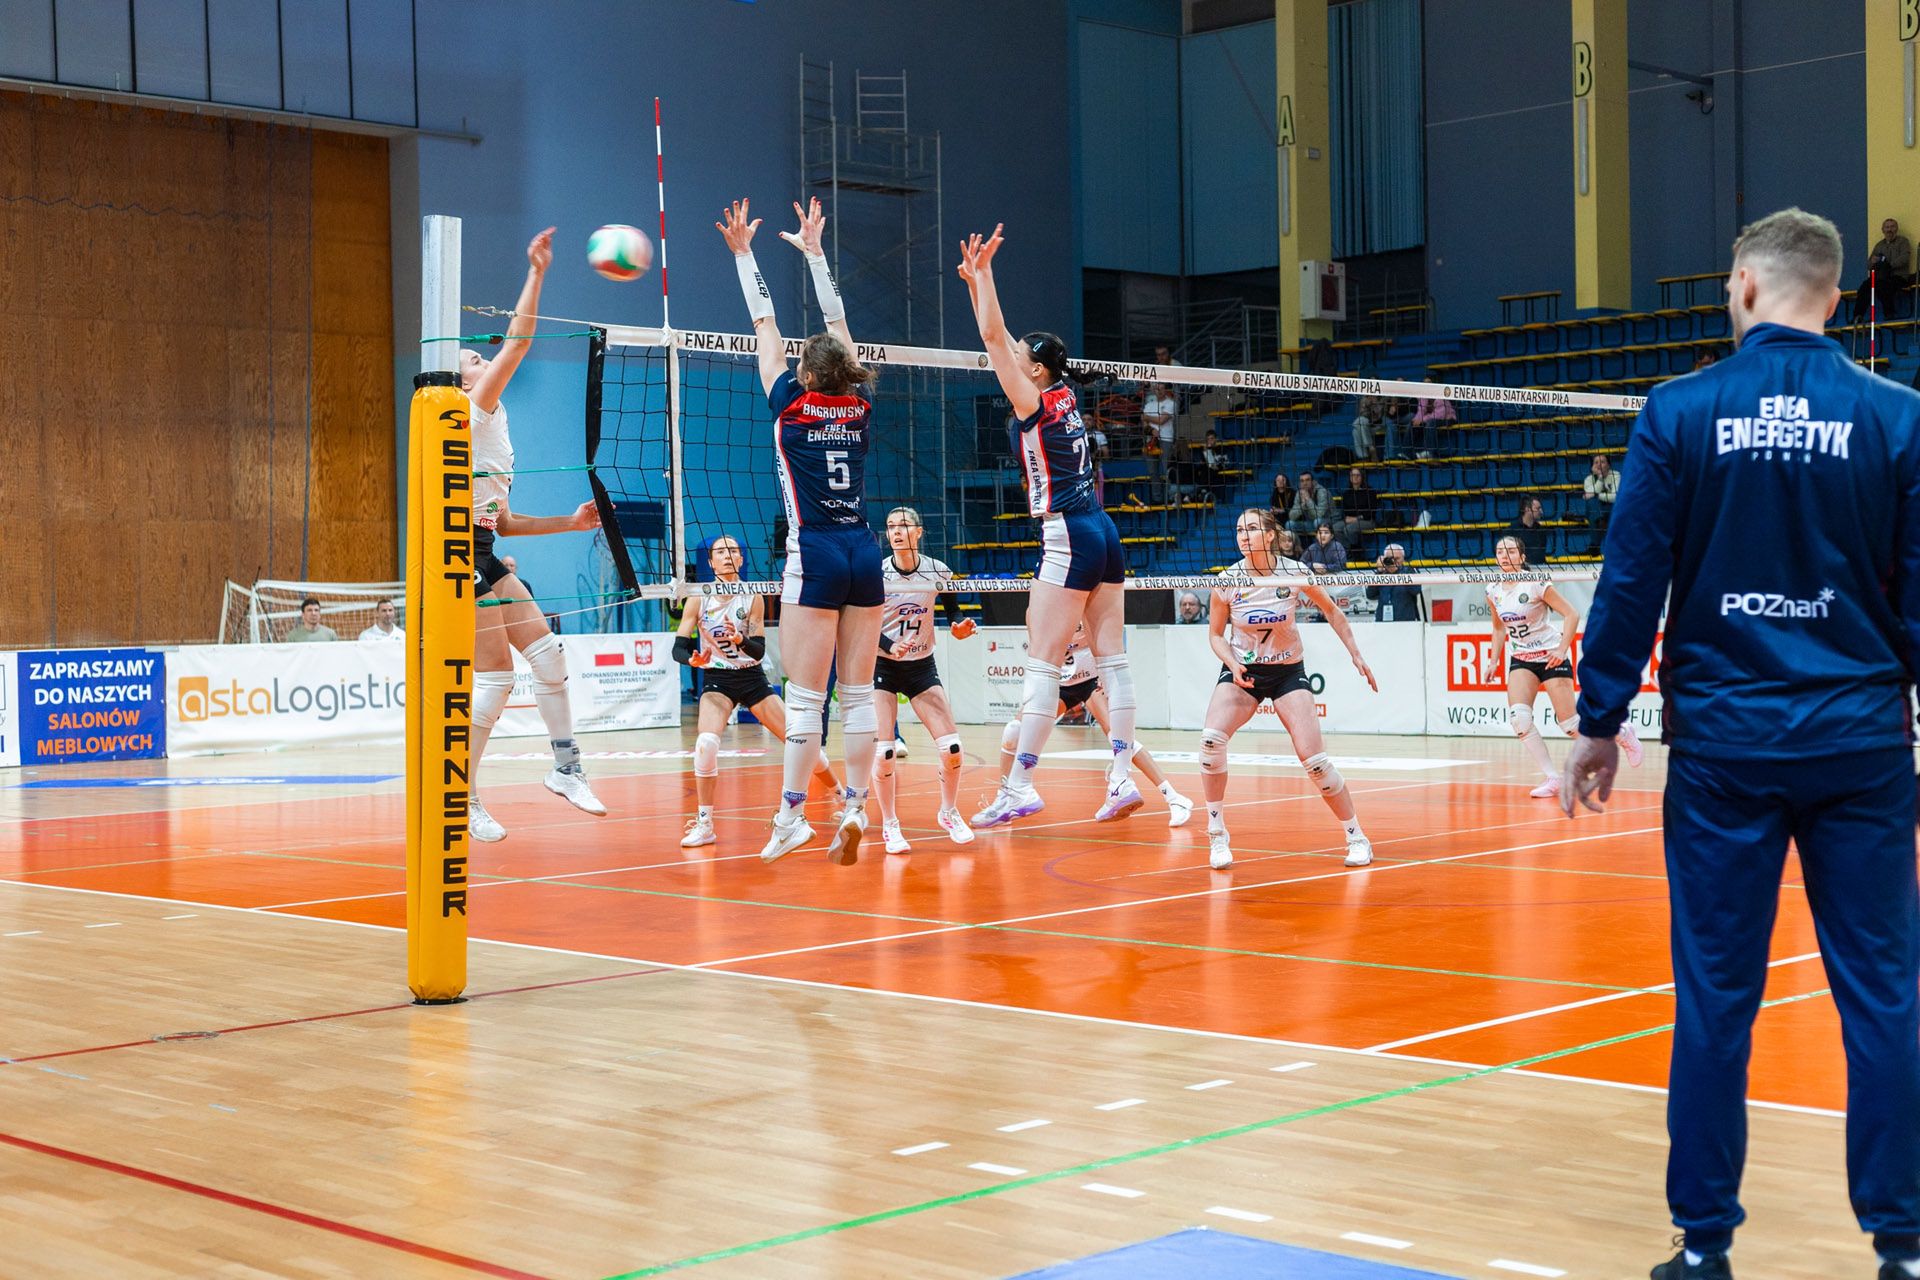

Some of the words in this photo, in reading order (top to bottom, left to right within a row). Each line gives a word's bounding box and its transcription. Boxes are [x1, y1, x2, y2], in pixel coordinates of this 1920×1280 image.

[1574, 41, 1592, 97] B
[1277, 95, 1296, 147] A
[685, 333, 725, 350] ENEA
[730, 336, 758, 353] KLU
[858, 346, 886, 362] PIŁA
[1132, 366, 1157, 380] PIŁA
[1244, 374, 1271, 387] ENEA
[1274, 375, 1300, 389] KLUB
[1302, 377, 1358, 392] SIATKARSKI
[1360, 381, 1381, 394] PIŁA
[1454, 388, 1477, 400] ENEA
[1479, 388, 1501, 400] KLUB
[1503, 390, 1550, 404] SIATKARSKI
[1552, 394, 1570, 404] PIŁA
[1631, 398, 1646, 409] ENE
[1759, 394, 1810, 420] ENEA
[808, 430, 862, 442] ENERGETYK
[824, 424, 846, 432] ENEA
[1716, 417, 1853, 460] ENERGETYK
[825, 450, 850, 490] 5
[442, 439, 470, 599] SPORT
[1144, 579, 1168, 588] ENEA
[1169, 578, 1190, 588] KLUB
[1192, 578, 1236, 588] SIATKARSKI
[1237, 578, 1255, 587] PIŁA
[1316, 576, 1336, 586] ENEA
[1338, 576, 1356, 586] KLUB
[1357, 576, 1396, 585] SIATKARSKI
[1398, 575, 1413, 584] PIŁA
[1466, 574, 1485, 582] ENEA
[1485, 574, 1502, 582] KLUB
[1502, 573, 1537, 582] SIATKARSKI
[1538, 572, 1552, 581] PIŁA
[716, 583, 746, 594] ENEA
[749, 582, 776, 594] KLUB
[946, 580, 972, 592] ENEA
[974, 580, 998, 591] KLUB
[1001, 580, 1031, 591] SIATKA
[898, 608, 928, 616] Enea
[1248, 614, 1286, 624] Enea
[898, 620, 922, 636] 14
[1256, 628, 1273, 644] 7
[1507, 624, 1530, 638] 22
[30, 660, 154, 680] ZAPRASZAMY
[987, 666, 1010, 676] CAŁA
[34, 688, 64, 706] DO
[68, 684, 151, 704] NASZYCH
[180, 673, 406, 721] astaLogistic
[48, 708, 140, 730] SALONÓW
[36, 734, 152, 756] MEBLOWYCH
[442, 659, 470, 918] TRANSFER
